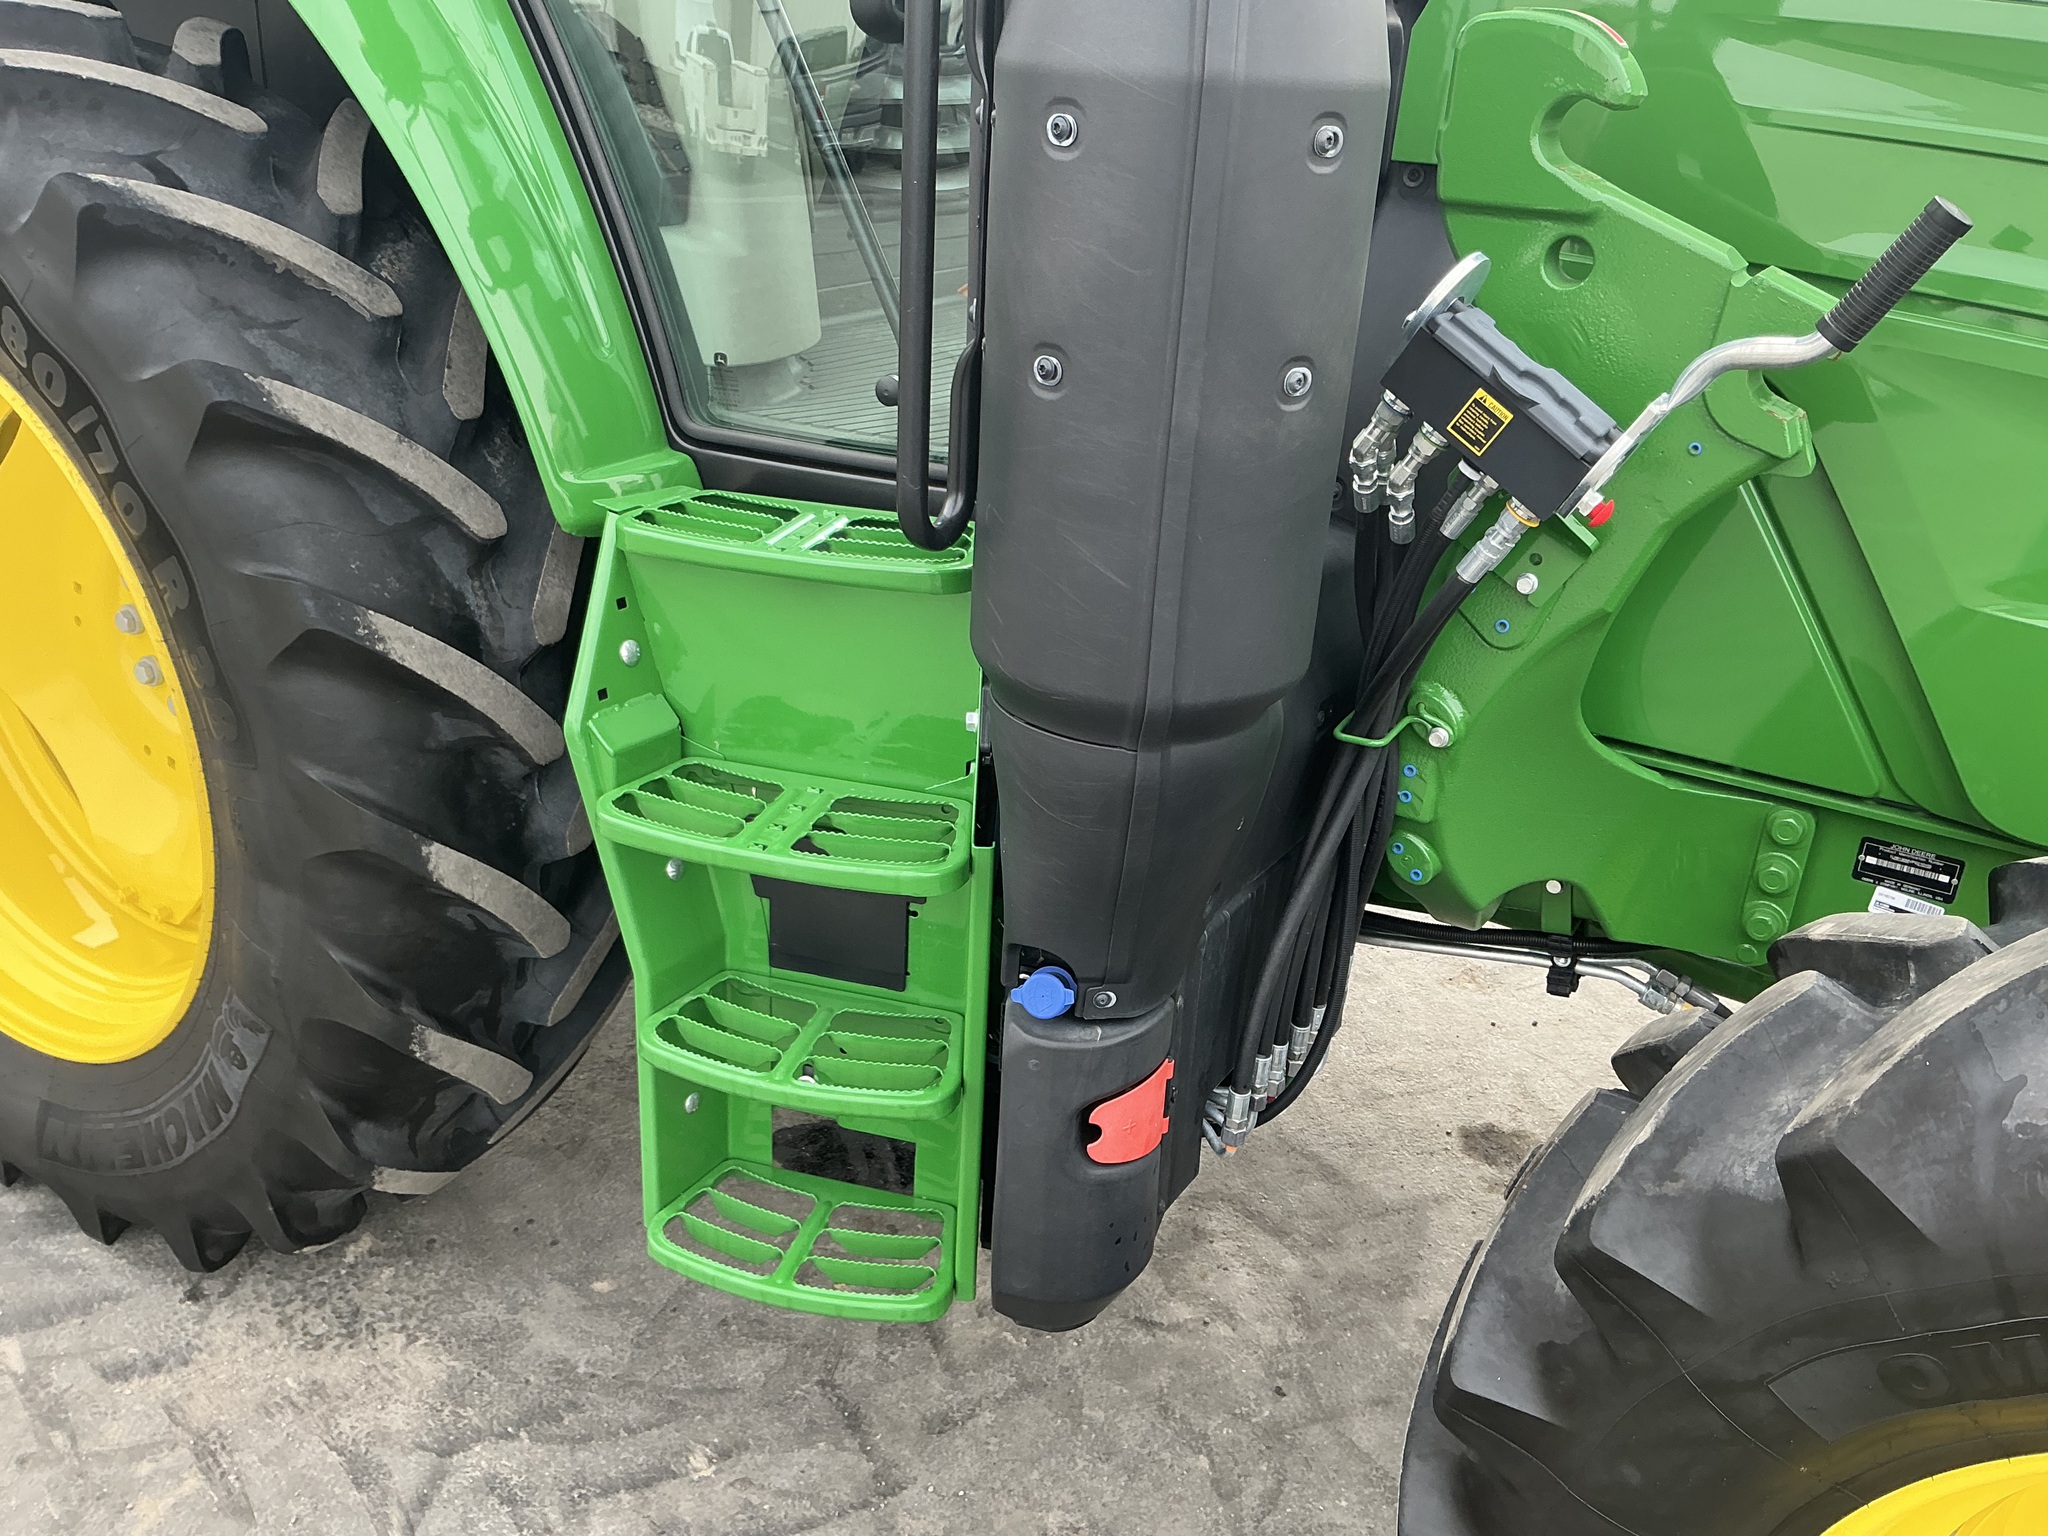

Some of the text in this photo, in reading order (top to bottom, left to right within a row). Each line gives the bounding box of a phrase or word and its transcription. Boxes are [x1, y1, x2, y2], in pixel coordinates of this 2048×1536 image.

[1488, 402, 1510, 421] CAUTION
[152, 555, 190, 617] R
[1890, 844, 1937, 860] JOHN DEERE
[46, 1061, 235, 1170] MICHEN
